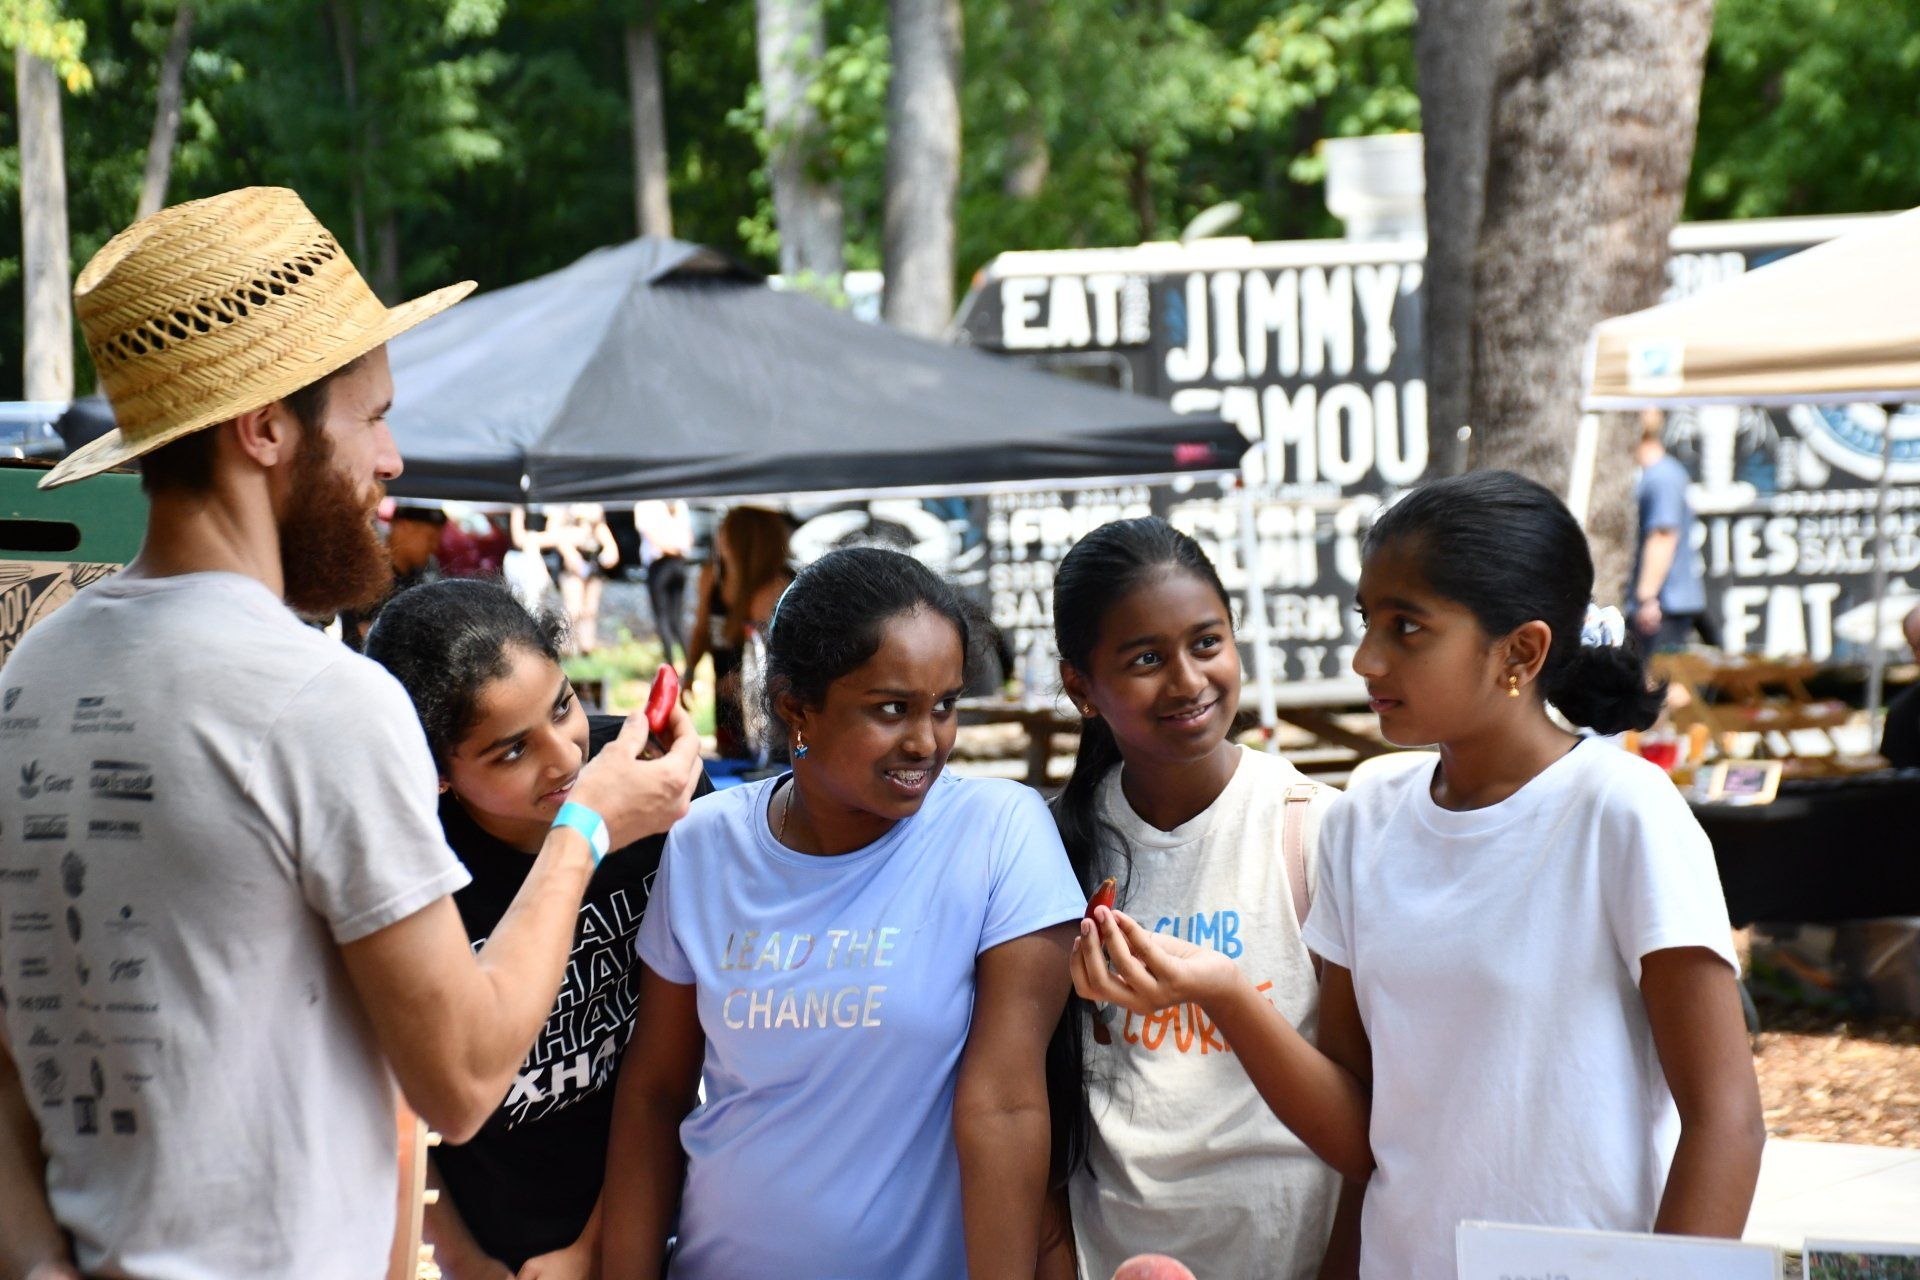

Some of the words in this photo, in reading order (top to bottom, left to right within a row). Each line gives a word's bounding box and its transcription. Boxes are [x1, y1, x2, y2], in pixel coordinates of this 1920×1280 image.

[1001, 275, 1122, 349] EAT
[720, 931, 815, 971] LEAD
[826, 927, 901, 970] THE
[722, 985, 887, 1030] CHANGE
